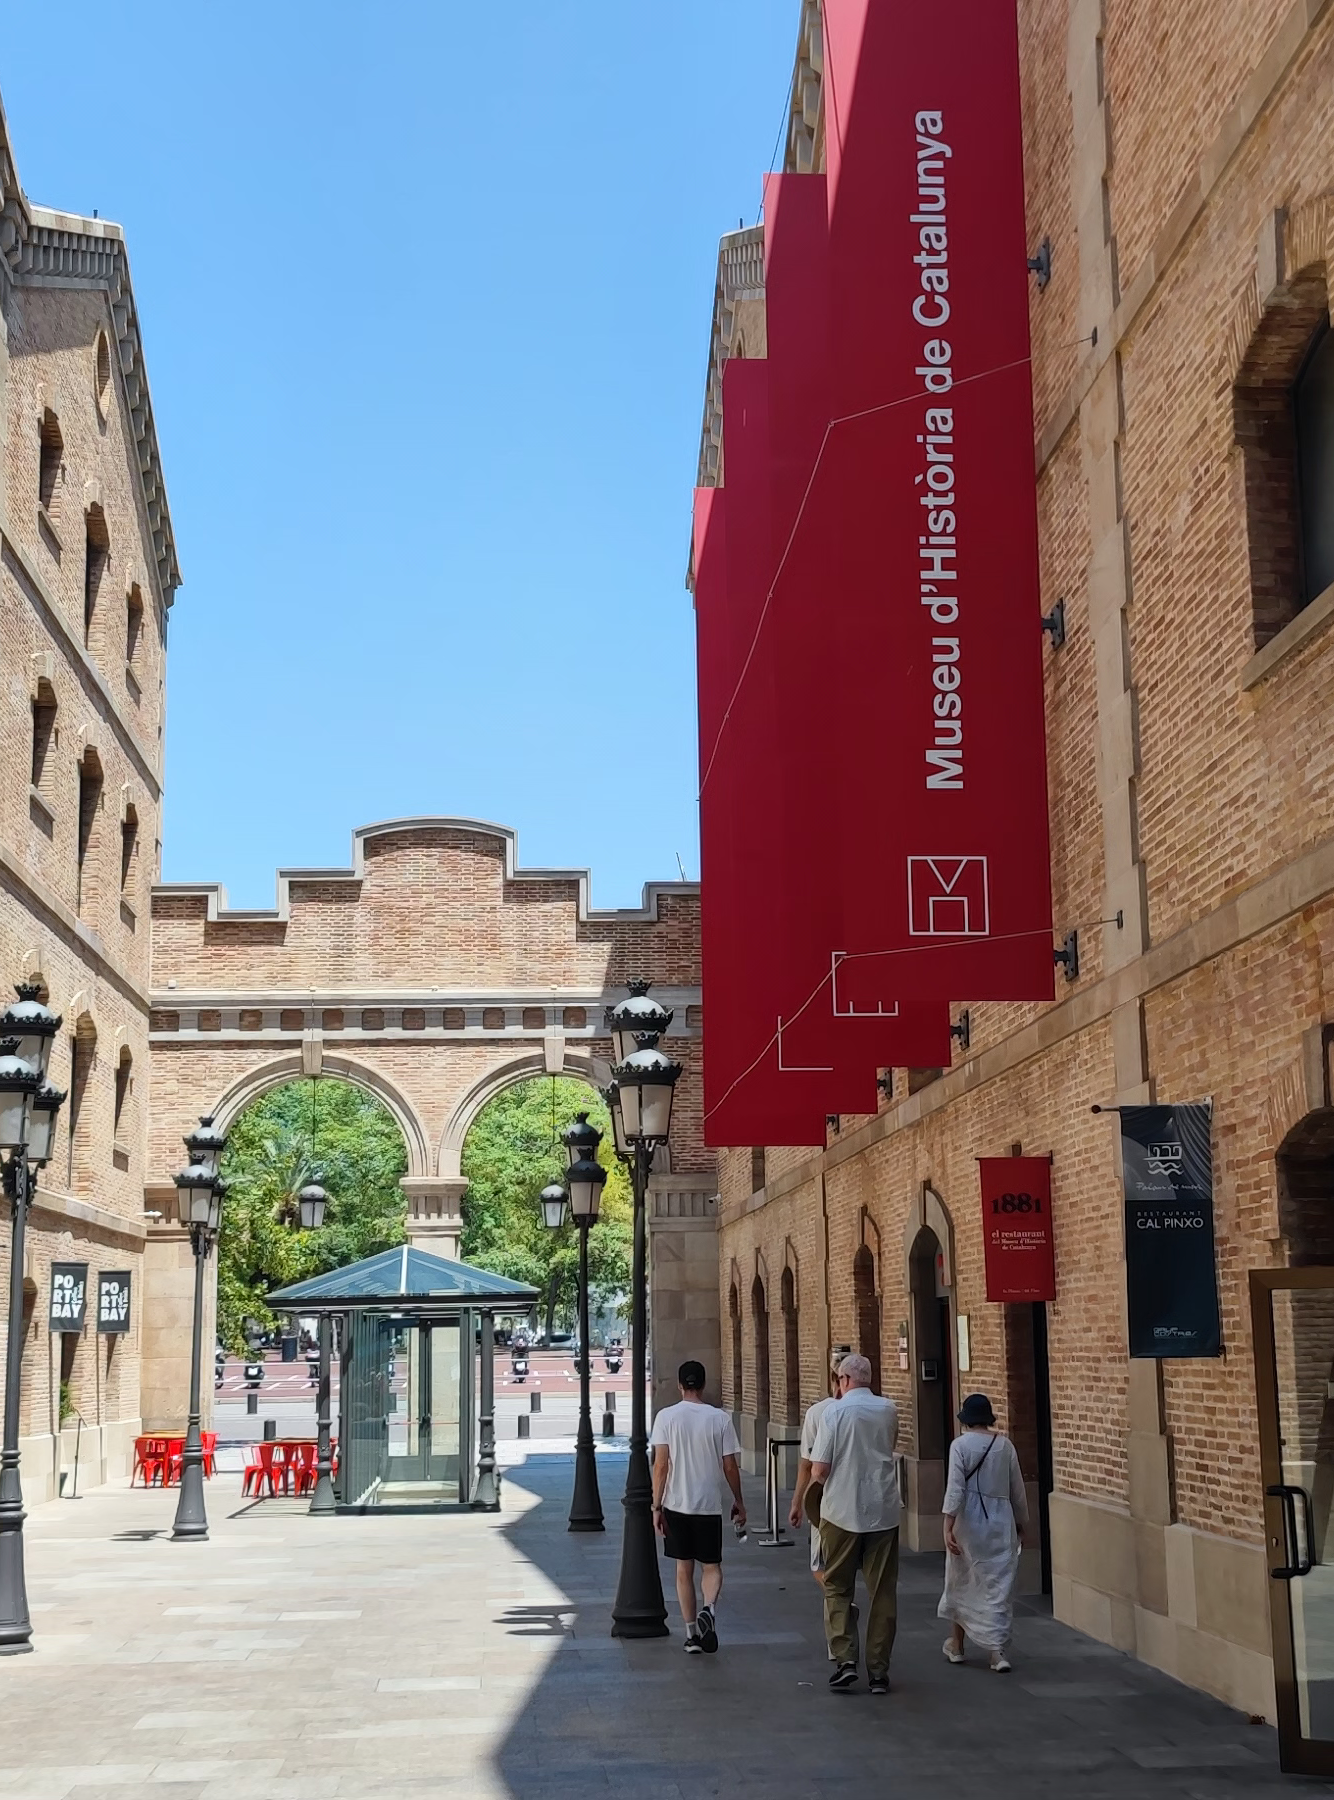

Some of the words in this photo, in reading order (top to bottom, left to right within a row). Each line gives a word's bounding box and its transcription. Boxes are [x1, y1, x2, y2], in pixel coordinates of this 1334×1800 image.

[909, 110, 953, 327] Catalunya
[915, 339, 952, 394] de
[925, 637, 964, 790] Museu
[991, 1192, 1043, 1214] 1881
[1136, 1218, 1161, 1229] CAL
[1164, 1217, 1204, 1229] PINXO
[991, 1229, 1000, 1238] el
[1001, 1230, 1046, 1238] restaurant
[53, 1274, 74, 1288] PO
[101, 1282, 119, 1294] PO
[51, 1303, 82, 1318] BAY
[100, 1308, 127, 1321] BAY
